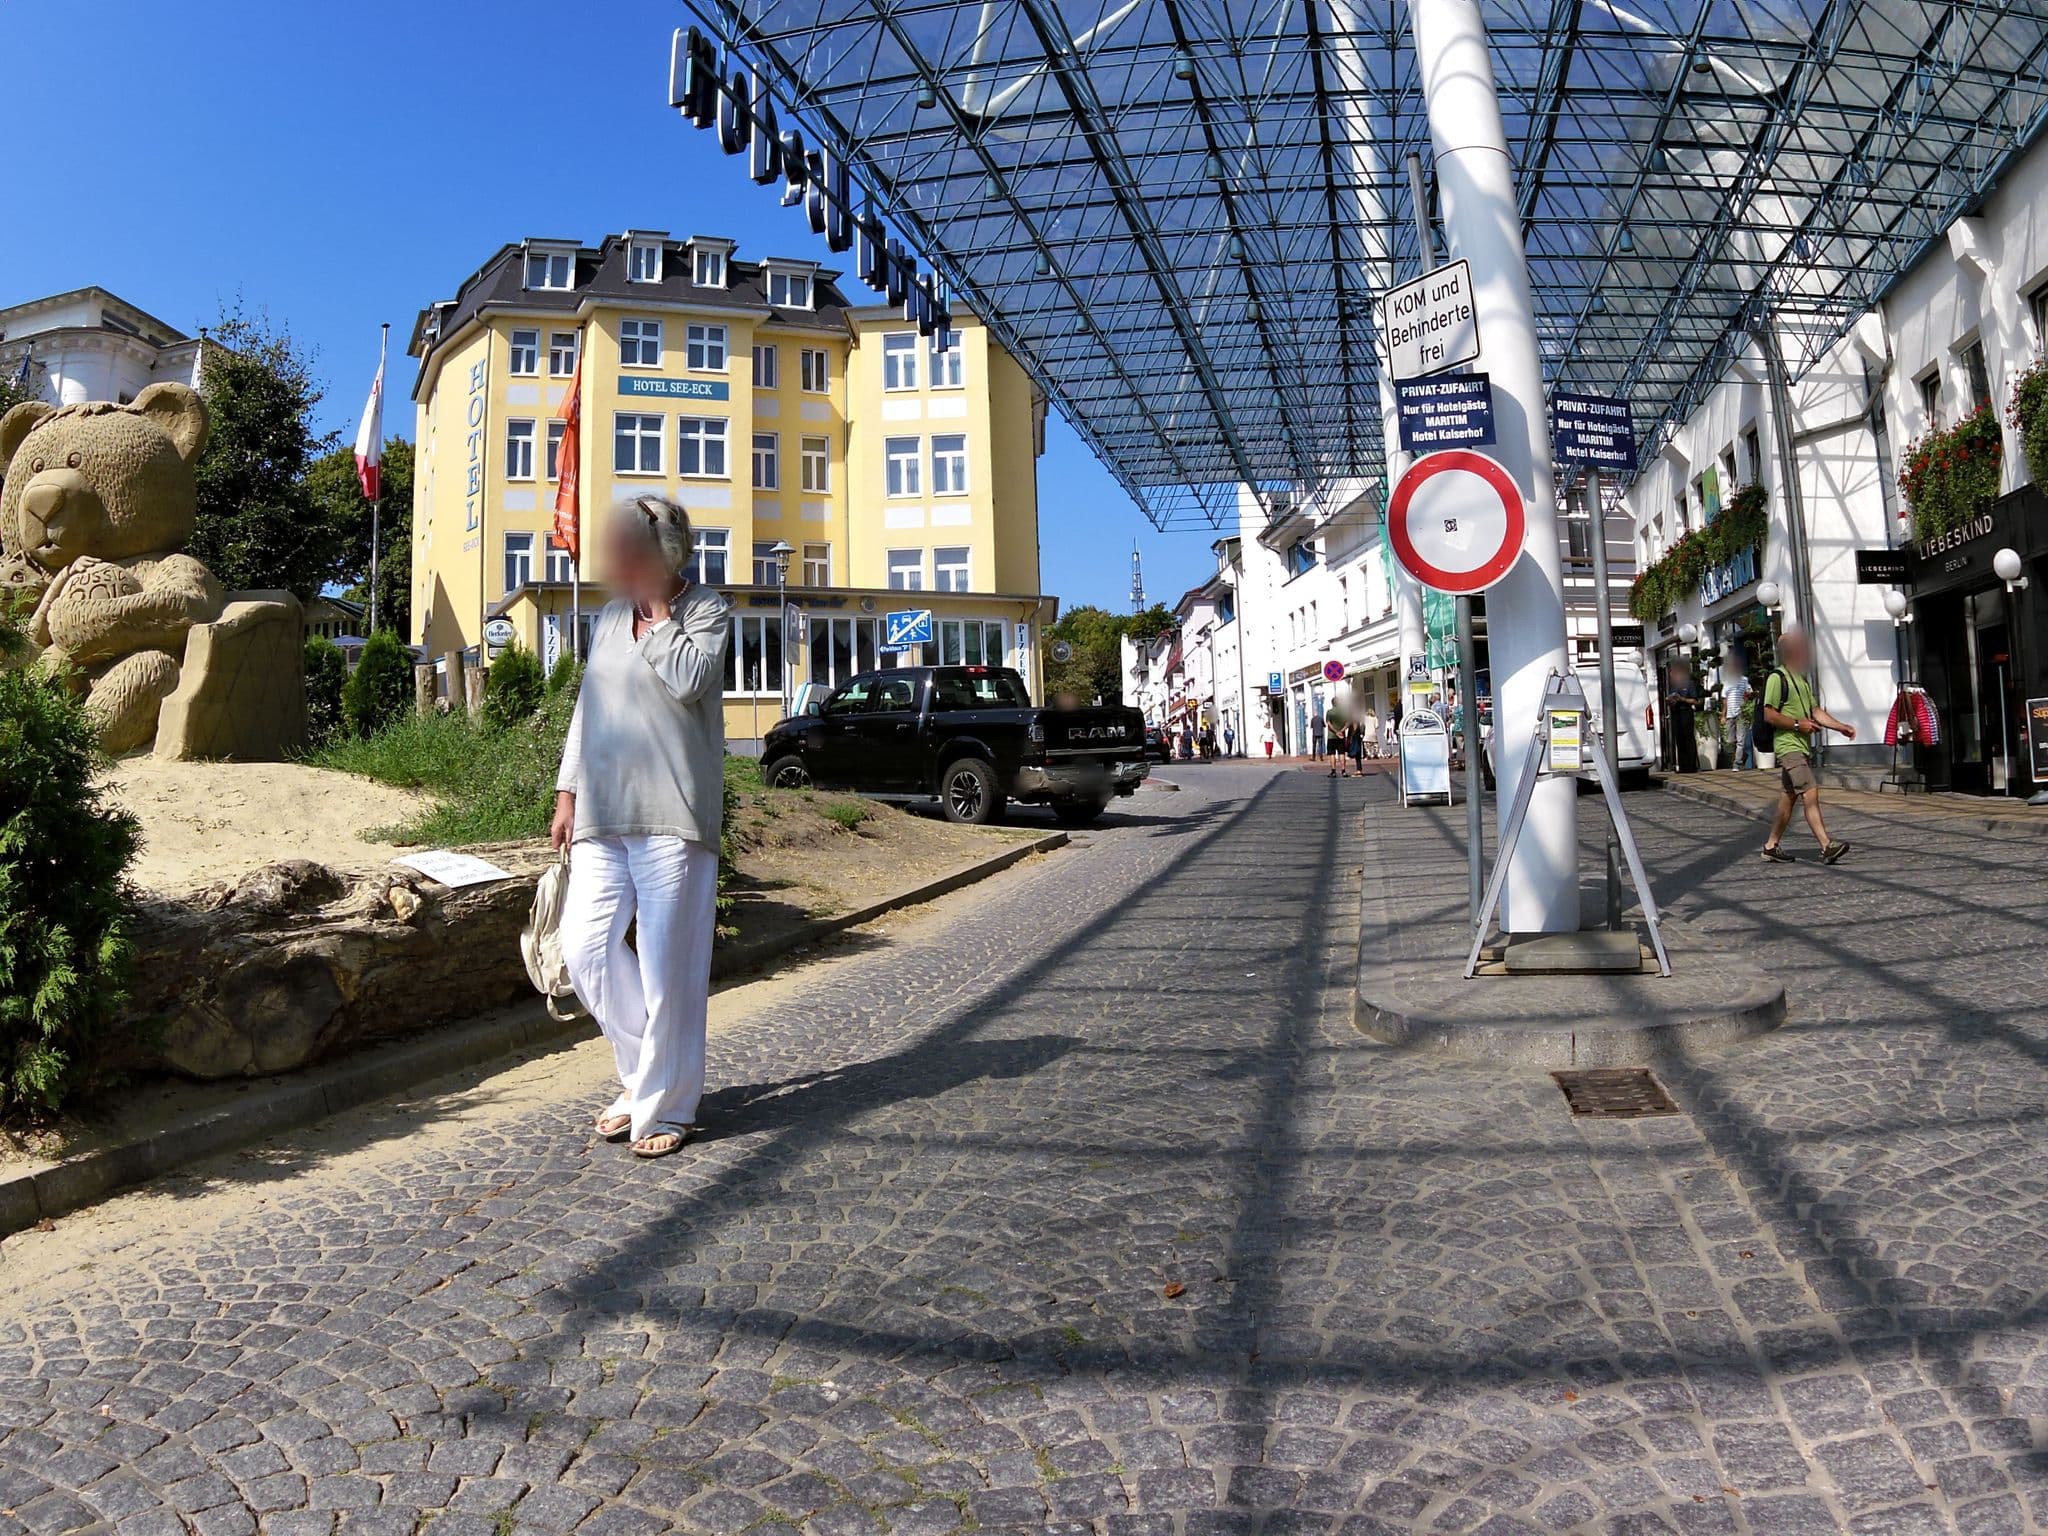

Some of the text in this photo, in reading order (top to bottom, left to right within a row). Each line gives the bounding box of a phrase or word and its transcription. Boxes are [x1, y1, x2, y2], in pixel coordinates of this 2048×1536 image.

[1394, 274, 1460, 319] KOM und
[1391, 304, 1470, 348] Behinderte
[1420, 338, 1445, 365] frei
[633, 380, 713, 396] HOTEL SEE-ECK
[1402, 381, 1485, 397] PRIVAT-ZUFAHRT
[1404, 400, 1487, 415] Nur für Hotelgäste
[1556, 400, 1627, 417] PRIVAT-ZUFAHRT
[1425, 414, 1468, 427] MARITIM
[1558, 418, 1630, 434] Nur für Hotelgäste
[1412, 426, 1484, 442] Hotel Kaiserhof
[1577, 433, 1614, 446] MARITIM
[465, 358, 487, 532] HOTEL
[1566, 446, 1627, 460] Hotel Kaiserhof
[1919, 514, 1993, 560] LIEBESKIND
[1944, 556, 1968, 572] BERLIN
[1414, 664, 1423, 672] H
[1271, 673, 1280, 683] P
[1068, 726, 1126, 739] RAM
